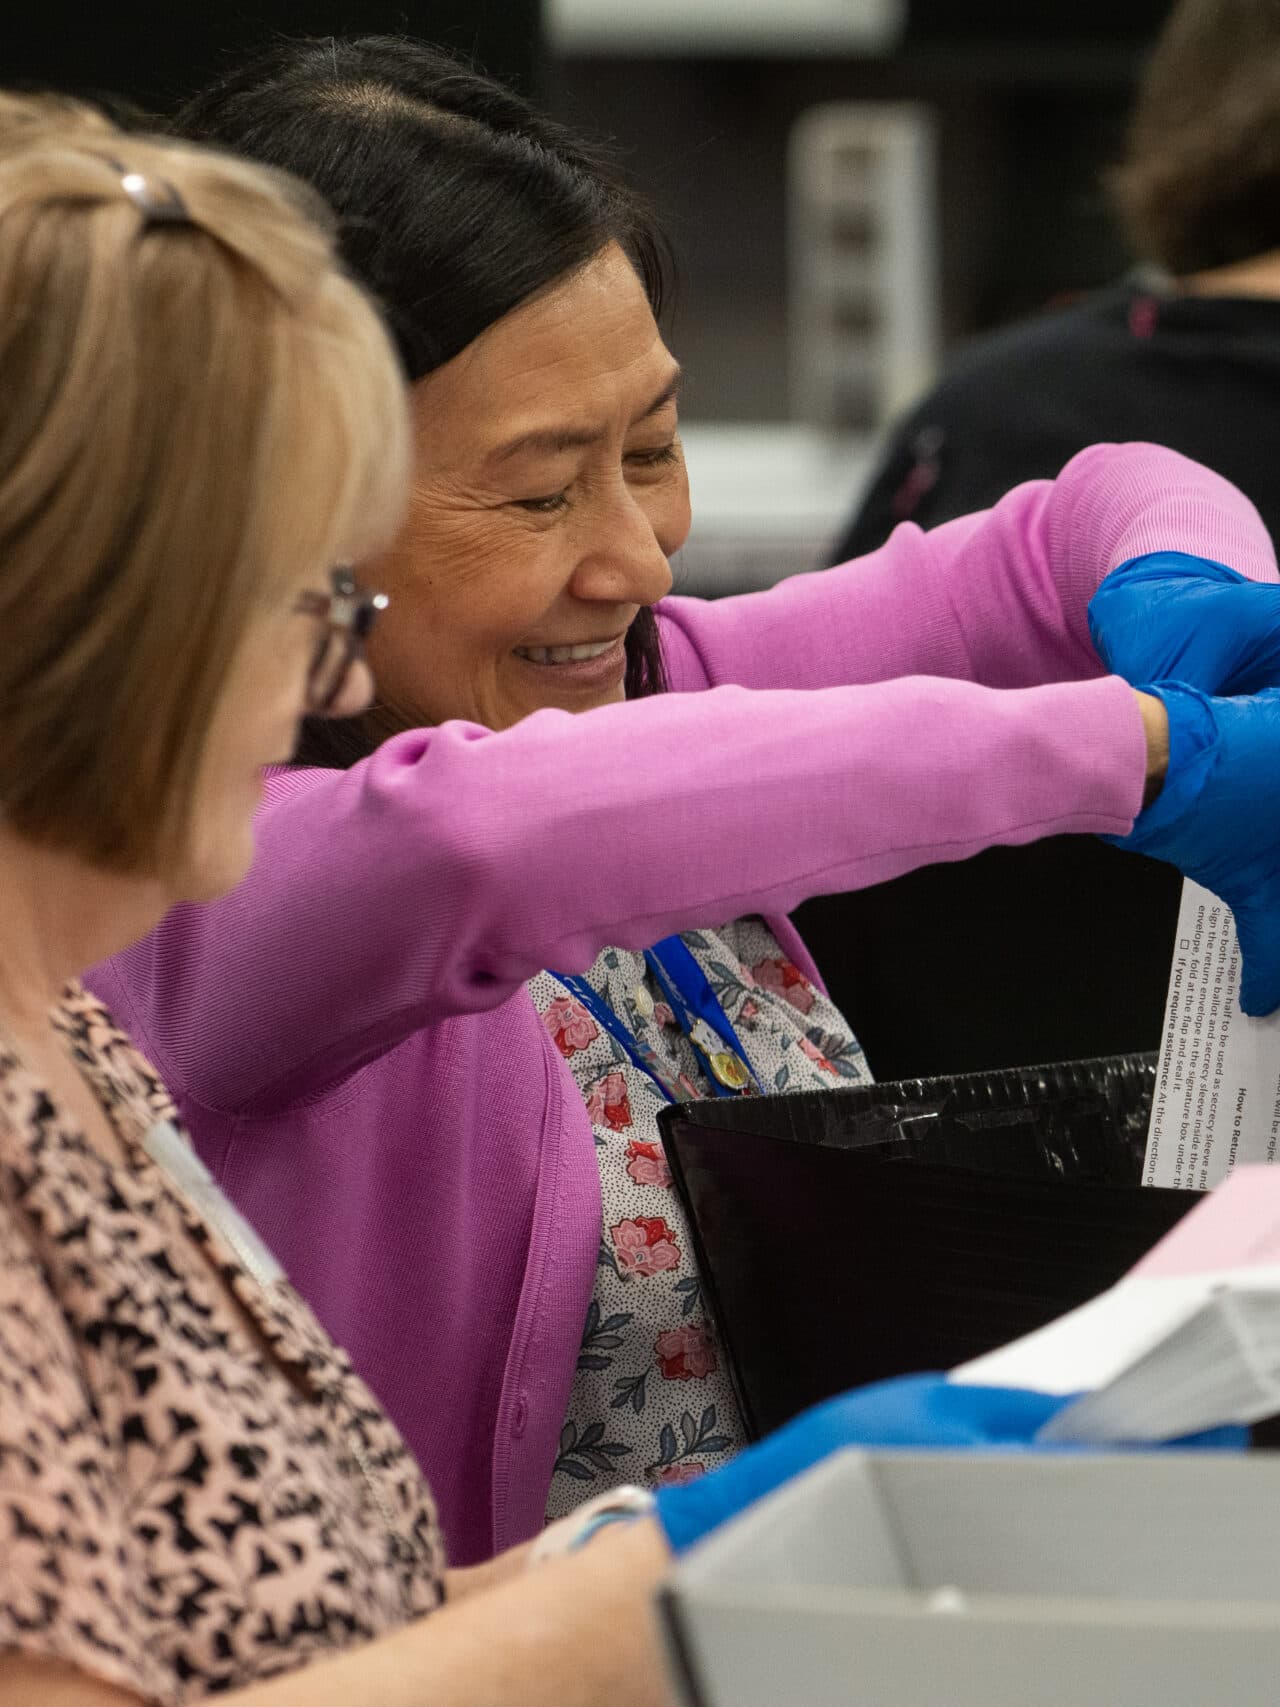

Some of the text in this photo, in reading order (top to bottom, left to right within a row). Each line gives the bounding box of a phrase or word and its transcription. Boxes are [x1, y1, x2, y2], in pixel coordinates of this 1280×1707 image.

[1208, 906, 1221, 928] Sign
[1206, 931, 1216, 949] the
[1177, 957, 1186, 966] If
[1200, 951, 1211, 984] return
[1226, 957, 1237, 982] page
[1173, 967, 1183, 988] you
[1172, 905, 1205, 1093] envelope, fold at the flap and seal it.
[1225, 985, 1235, 994] in
[1168, 990, 1179, 1029] require
[1192, 987, 1206, 1035] envelope
[1222, 997, 1233, 1017] half
[1220, 1020, 1229, 1031] to
[1185, 908, 1233, 1190] Place both the ballot and secrecy sleeve inside the ret
[1192, 1037, 1202, 1047] in
[1218, 1034, 1228, 1047] be
[1159, 1031, 1174, 1089] assistance:
[1189, 1050, 1199, 1068] the
[1214, 1050, 1224, 1075] used
[1182, 1070, 1196, 1119] signature
[1212, 1078, 1220, 1089] as
[1157, 1092, 1167, 1104] At
[1234, 1087, 1246, 1112] How
[1154, 1106, 1165, 1124] the
[1204, 1092, 1218, 1131] secrecy
[1232, 1115, 1241, 1126] to
[1179, 1122, 1190, 1141] box
[1270, 1120, 1280, 1133] be
[1147, 1126, 1163, 1173] direction
[1201, 1133, 1213, 1166] sleeve
[1227, 1129, 1240, 1165] Return
[1266, 1136, 1277, 1166] rejec
[1174, 1143, 1185, 1175] under
[1198, 1169, 1208, 1189] and
